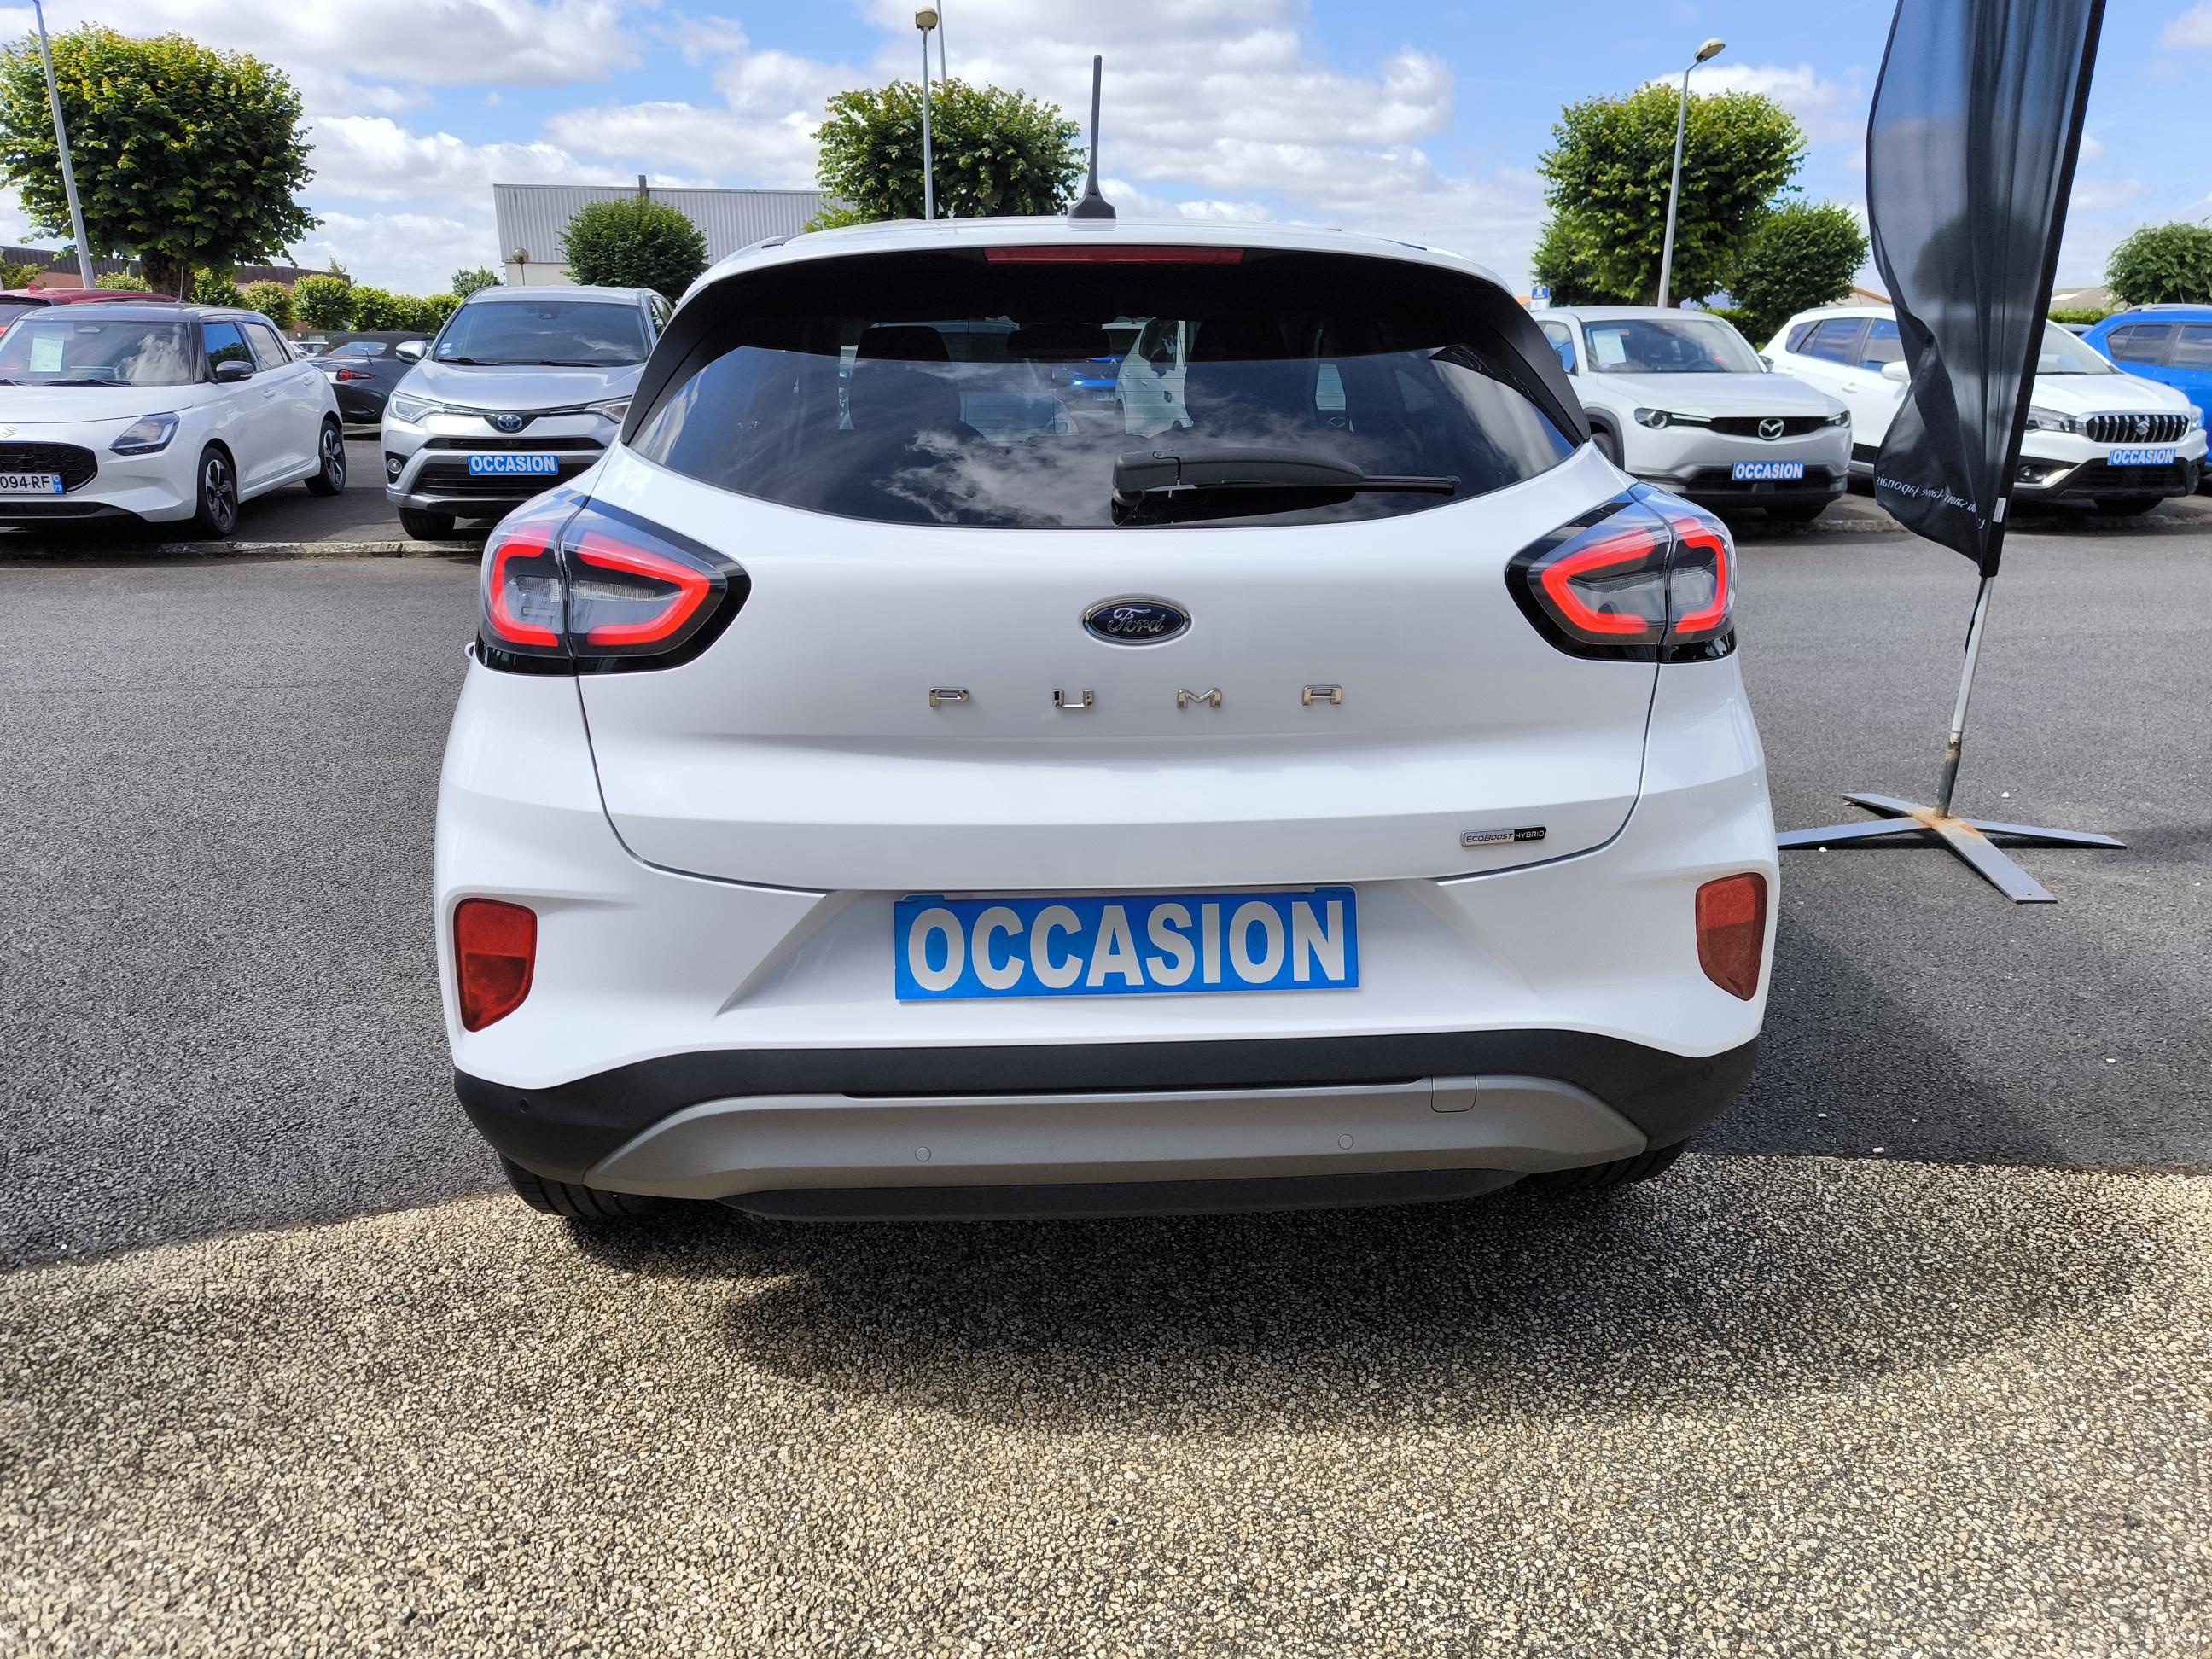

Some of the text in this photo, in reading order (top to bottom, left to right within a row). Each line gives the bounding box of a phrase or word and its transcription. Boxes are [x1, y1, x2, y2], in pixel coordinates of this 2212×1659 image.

[470, 456, 556, 472] OCCASION
[2113, 449, 2174, 464] OCCASION
[1735, 463, 1803, 479] OCCASION
[1106, 607, 1167, 633] Ford
[929, 684, 1343, 709] PUMA
[1515, 830, 1545, 840] HYBRID
[907, 900, 1346, 992] OCCASION
